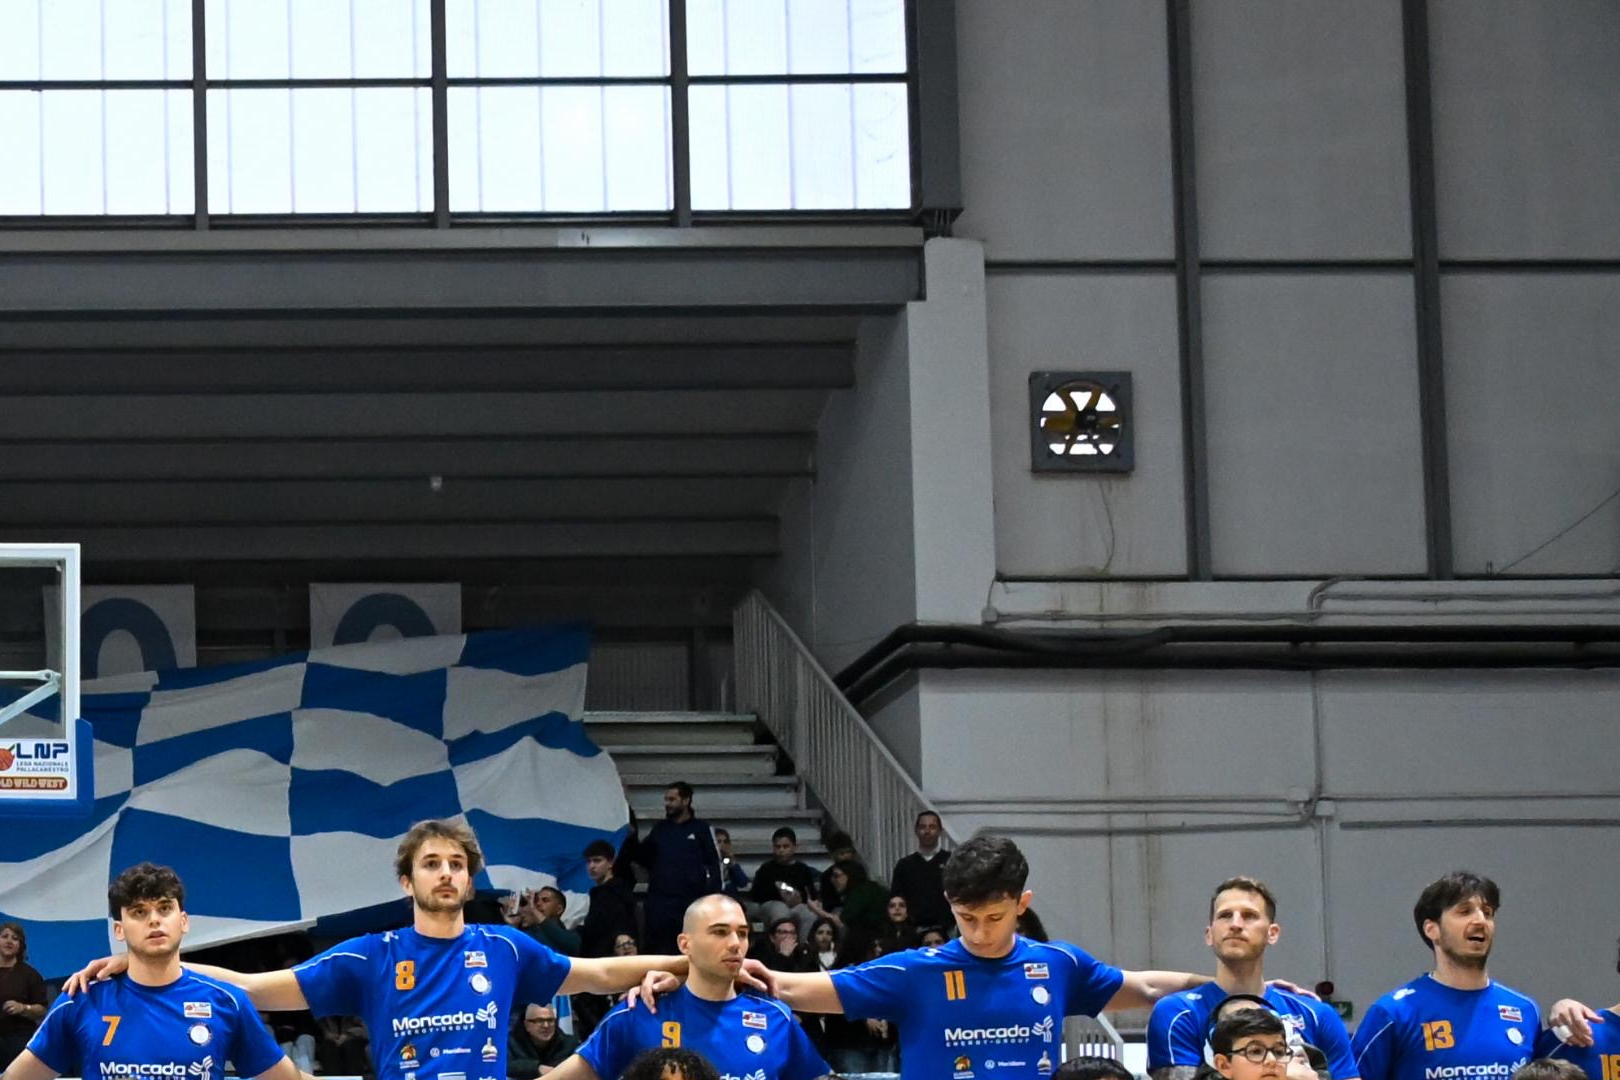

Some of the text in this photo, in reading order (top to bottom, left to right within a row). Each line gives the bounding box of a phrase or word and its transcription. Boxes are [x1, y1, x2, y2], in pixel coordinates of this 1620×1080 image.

[16, 742, 69, 759] LNP
[14, 778, 38, 788] WILD
[38, 778, 65, 788] WEST
[395, 960, 415, 991] 8
[943, 970, 967, 1001] 11
[101, 1016, 122, 1047] 7
[392, 1010, 475, 1032] Moncada
[662, 1021, 681, 1049] 9
[944, 1024, 1030, 1041] Moncada
[1421, 1020, 1455, 1051] 13
[99, 1061, 186, 1075] Moncada
[1425, 1062, 1509, 1080] Moncada
